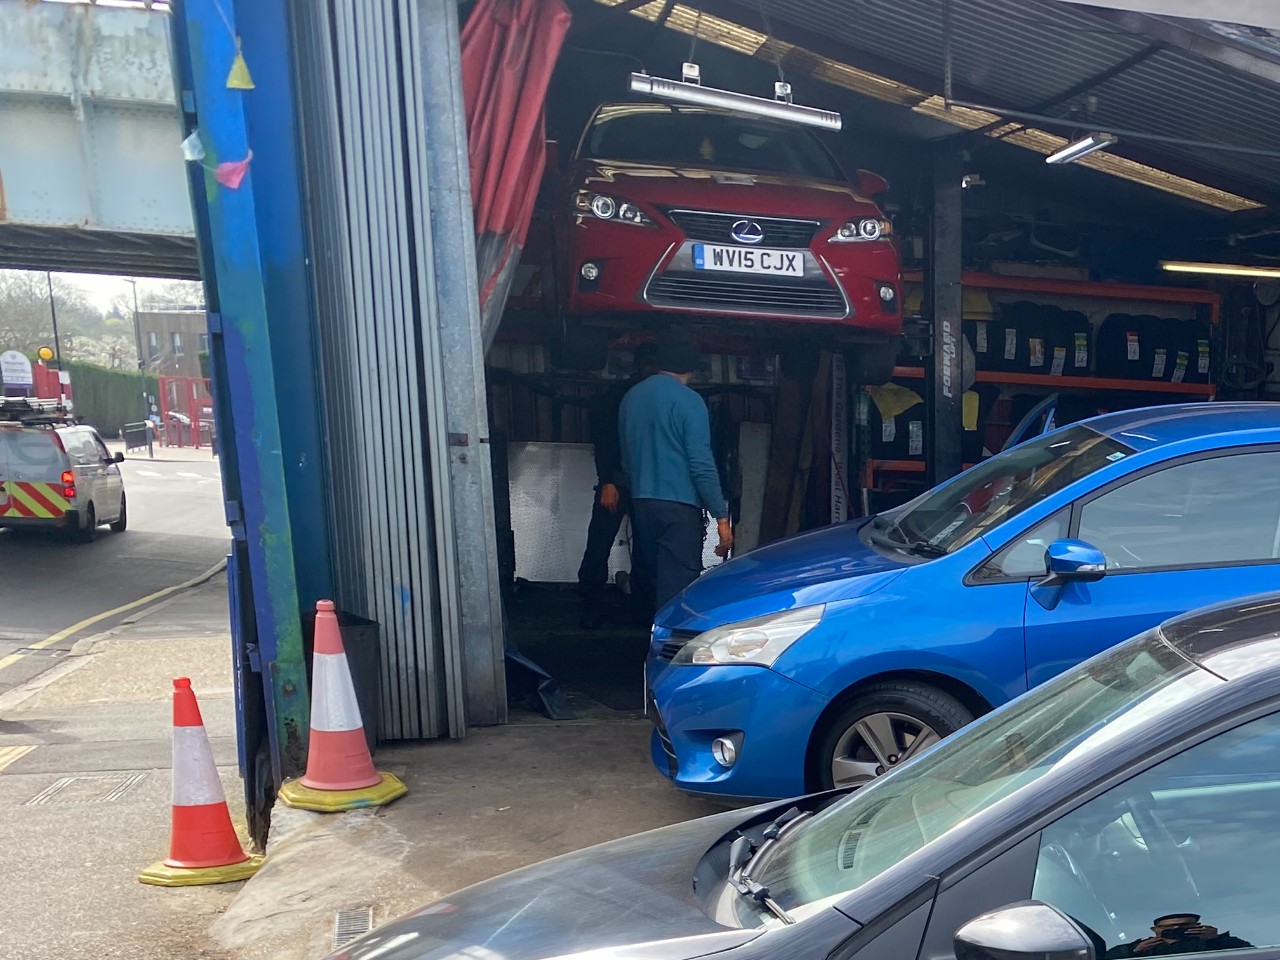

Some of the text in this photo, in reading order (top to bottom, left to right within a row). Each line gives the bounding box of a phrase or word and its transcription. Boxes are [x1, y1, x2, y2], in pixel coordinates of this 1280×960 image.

[713, 248, 796, 272] WV15 CJX
[943, 320, 953, 398] FORWARD
